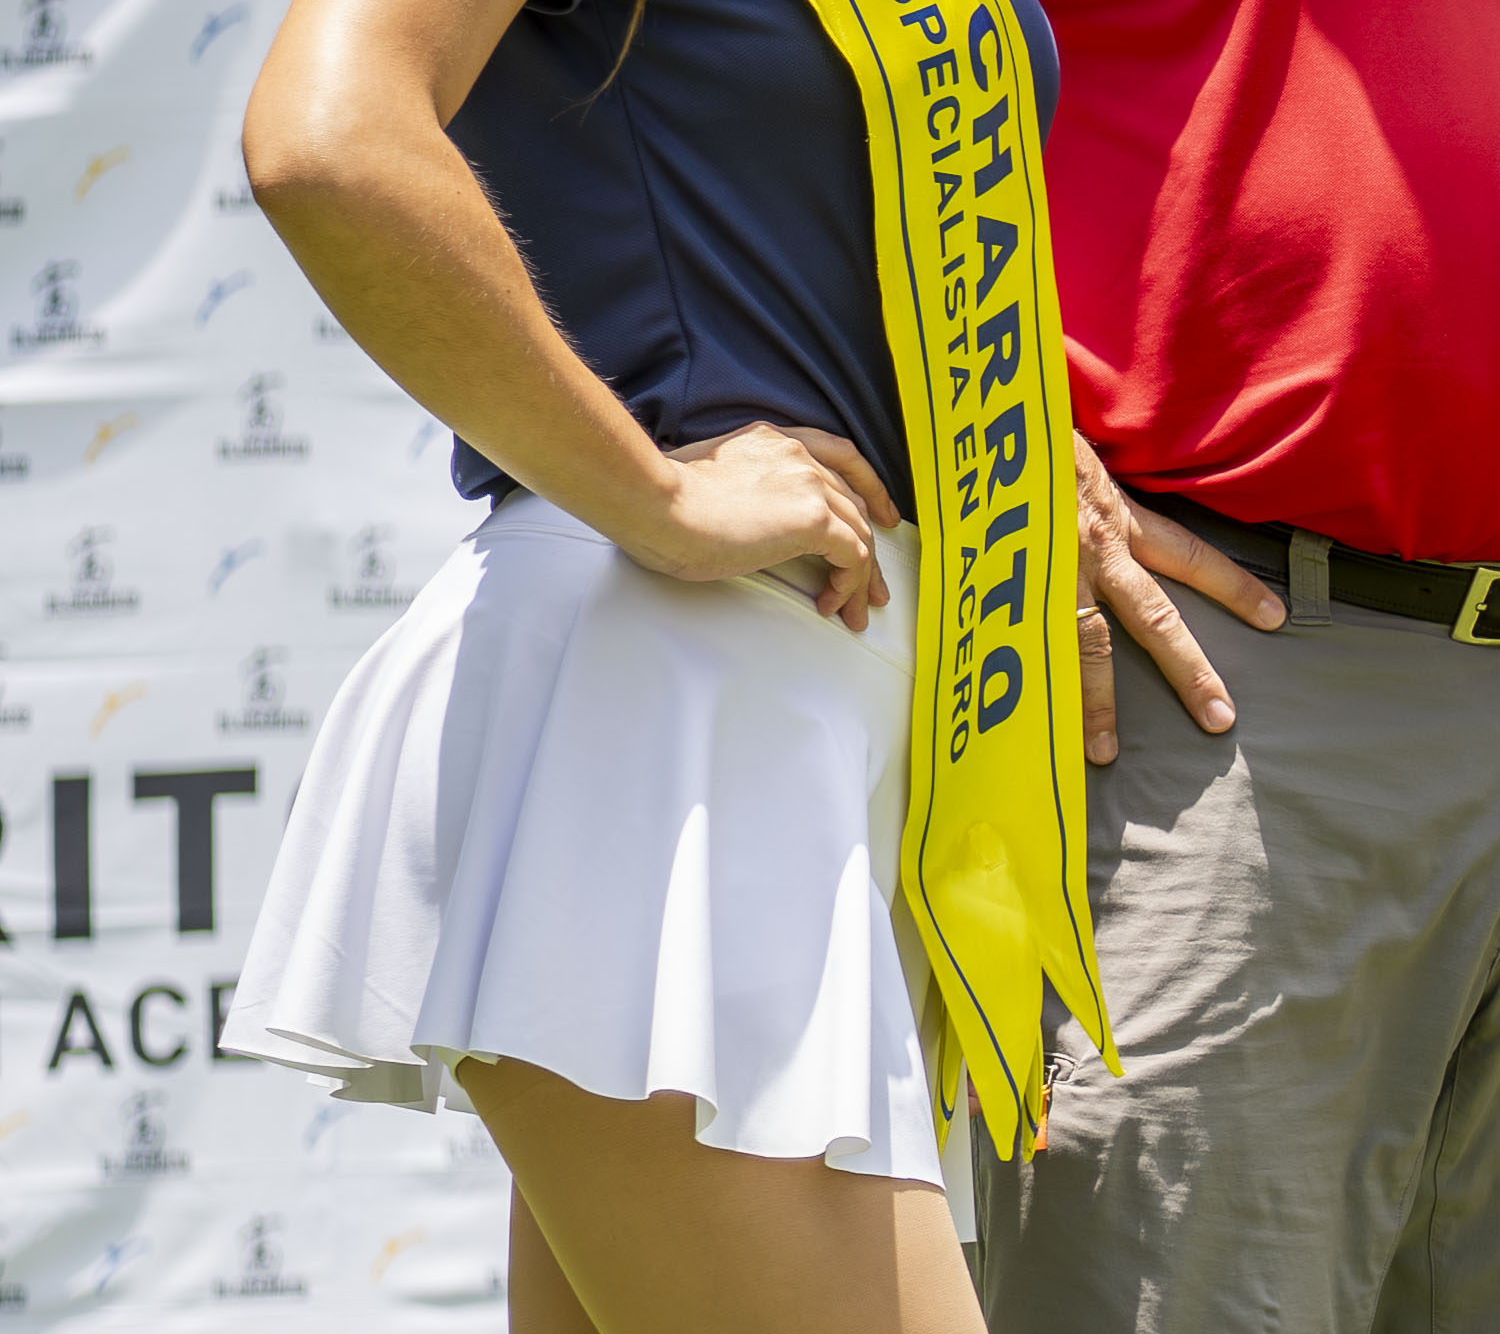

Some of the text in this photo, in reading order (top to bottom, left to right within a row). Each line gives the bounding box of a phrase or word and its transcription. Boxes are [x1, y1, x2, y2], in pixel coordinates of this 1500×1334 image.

[964, 3, 1029, 735] CHARRITO
[951, 424, 980, 522] EN
[950, 545, 977, 765] ACERO
[0, 765, 296, 946] IT
